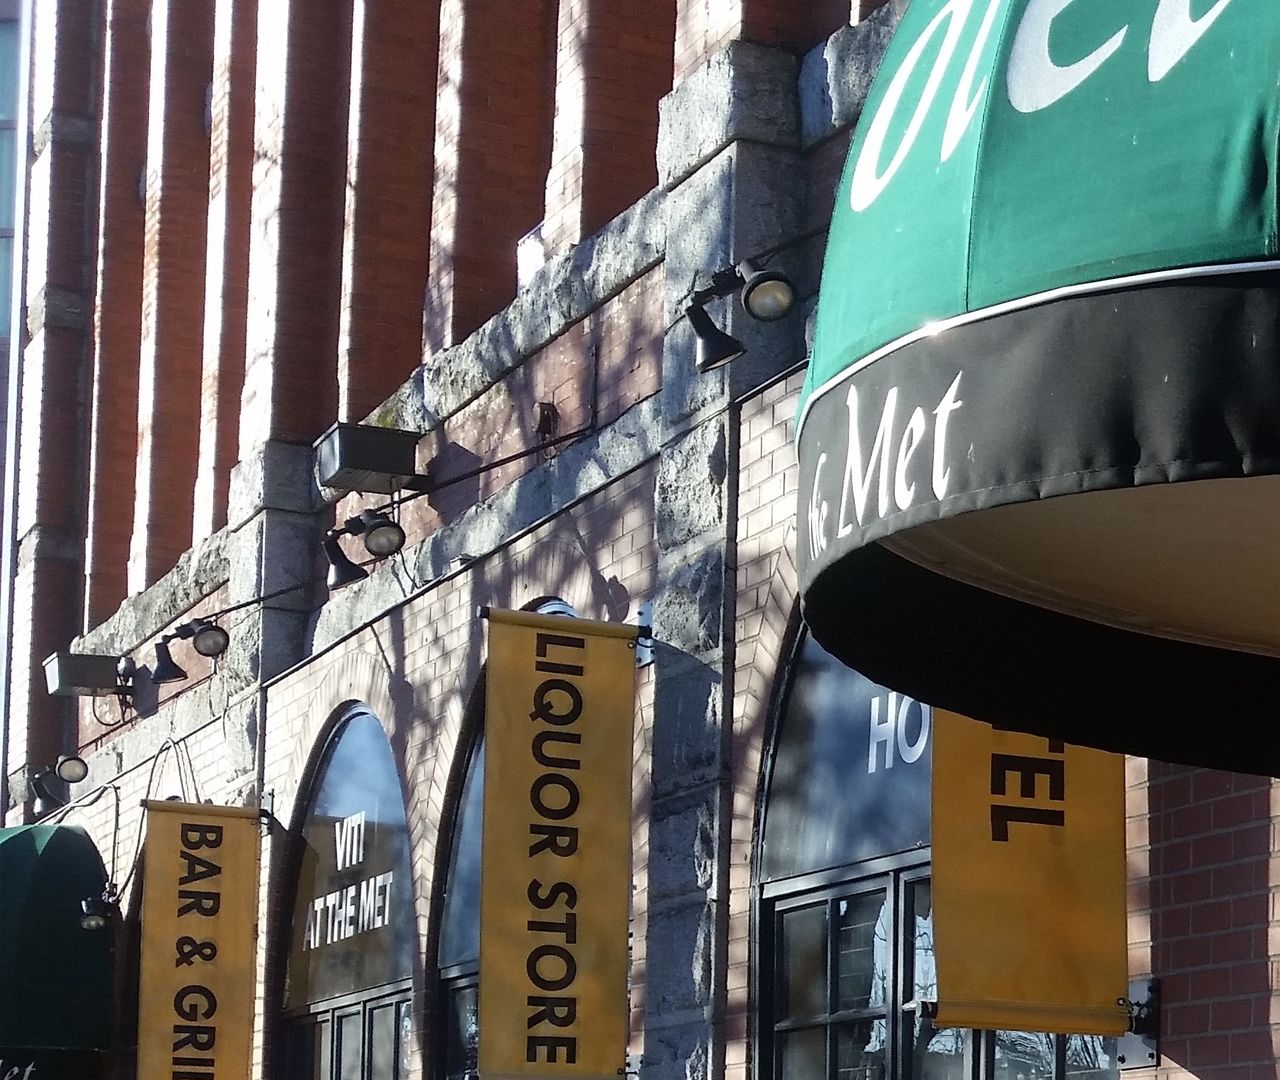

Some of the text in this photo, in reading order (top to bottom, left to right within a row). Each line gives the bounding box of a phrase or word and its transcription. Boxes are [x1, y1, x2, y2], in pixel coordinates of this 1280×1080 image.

[808, 370, 963, 561] the Met
[990, 722, 1065, 842] EL
[177, 822, 224, 919] BAR
[525, 631, 585, 1065] LIQUOR STORE
[175, 936, 218, 968] &
[303, 870, 394, 952] AT THE MET
